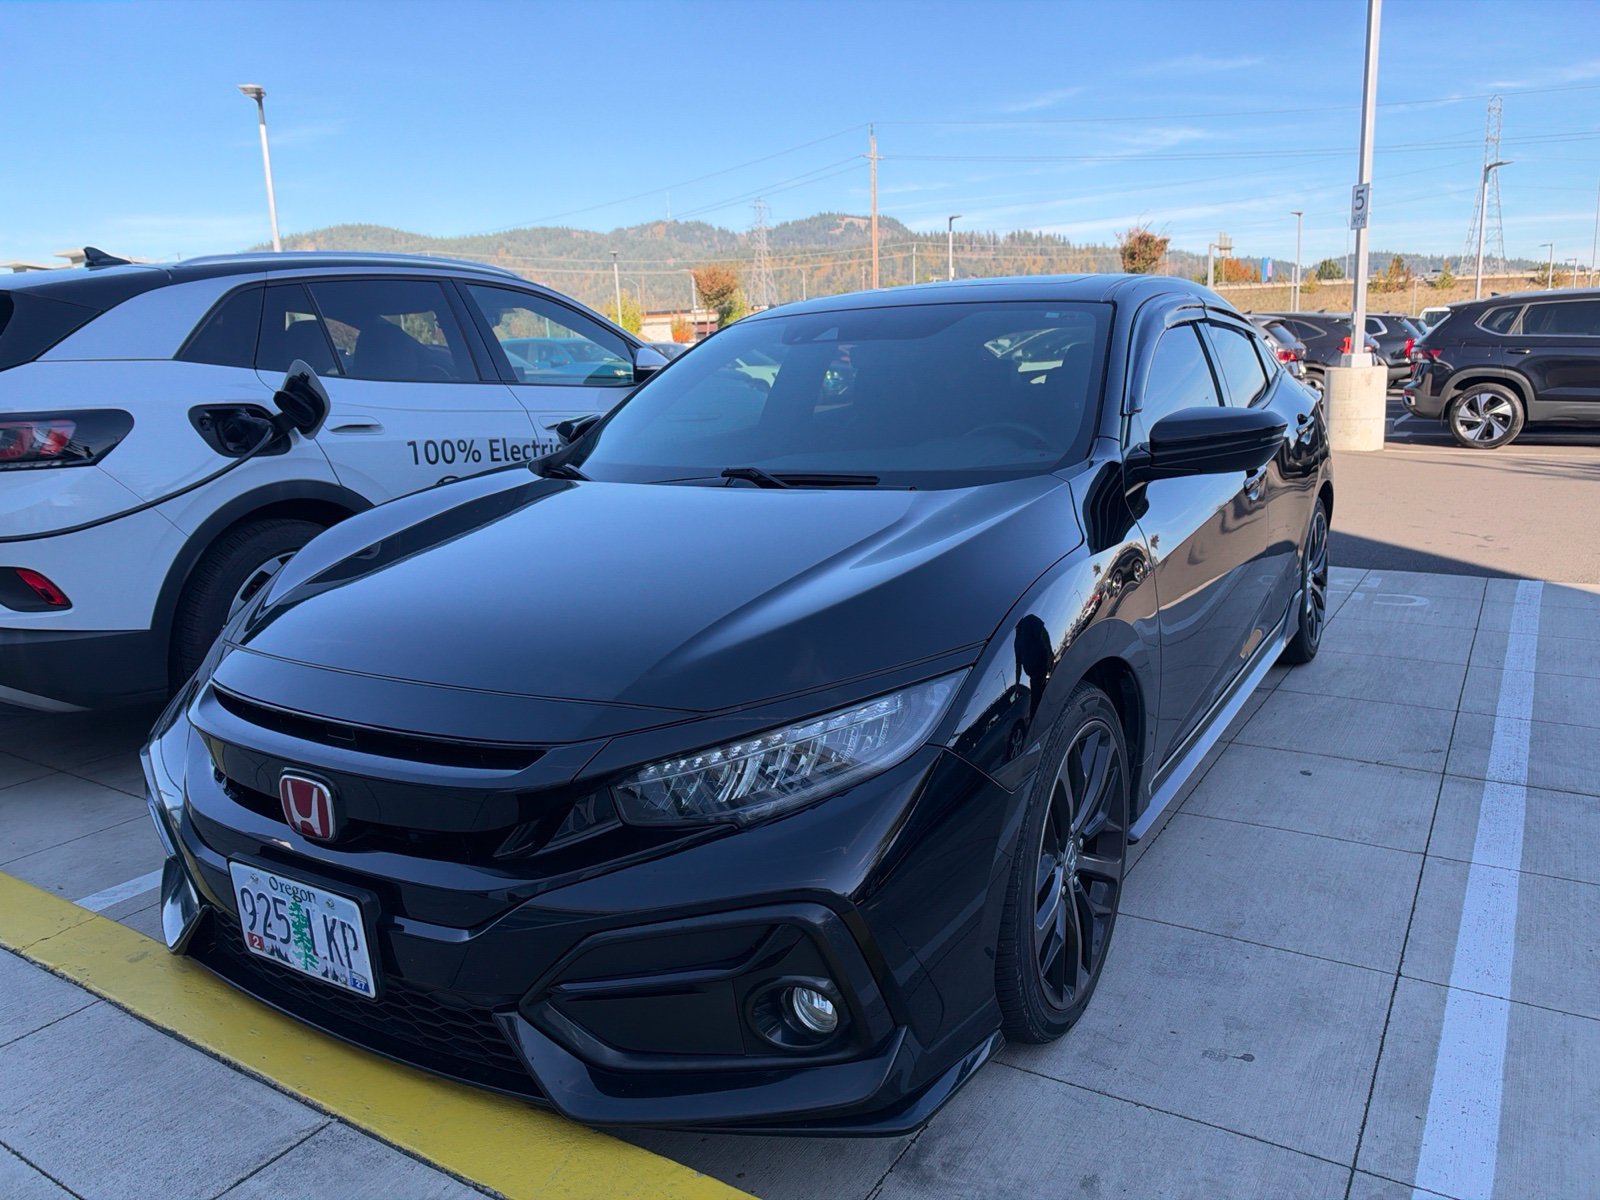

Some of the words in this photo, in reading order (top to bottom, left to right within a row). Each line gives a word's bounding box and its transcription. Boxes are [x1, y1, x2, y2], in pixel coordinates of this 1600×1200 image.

[1355, 189, 1365, 211] 5
[407, 439, 482, 466] 100%
[268, 876, 317, 904] Oregon
[240, 887, 292, 945] 925
[252, 935, 262, 949] 2
[355, 979, 366, 990] 27
